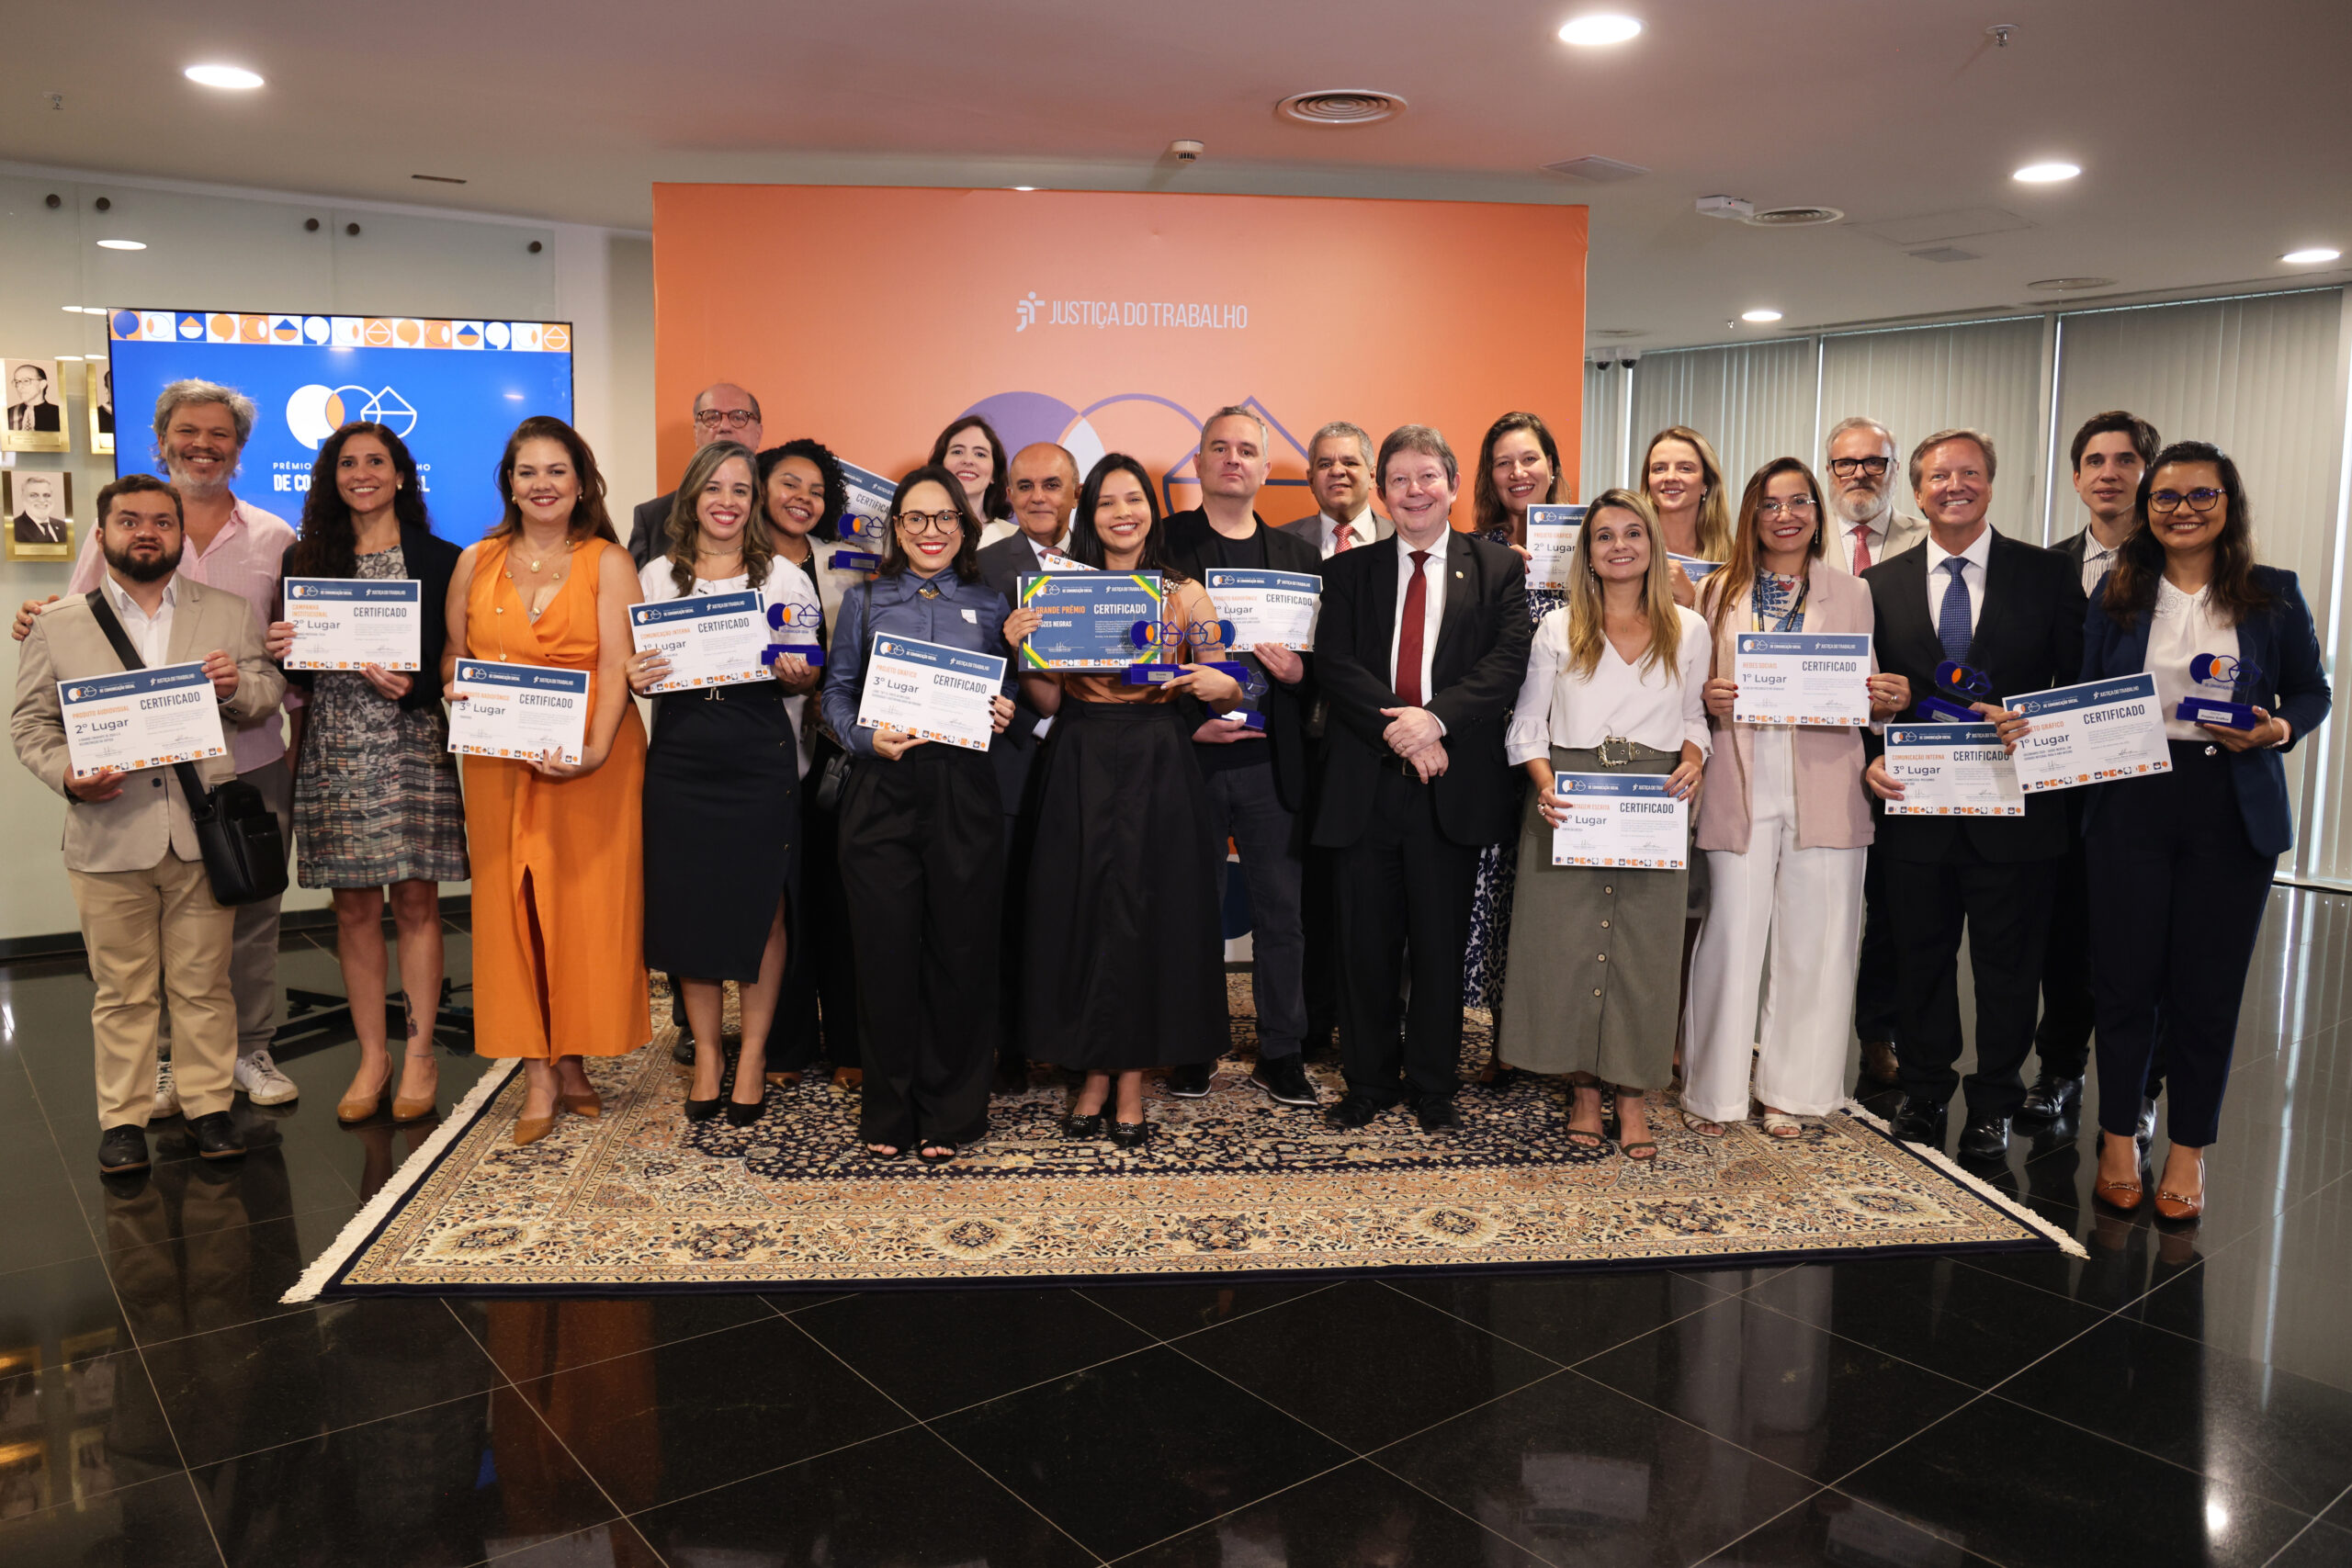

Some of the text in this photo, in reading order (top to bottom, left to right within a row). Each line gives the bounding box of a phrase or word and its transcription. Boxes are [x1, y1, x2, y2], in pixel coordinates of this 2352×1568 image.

[1049, 301, 1248, 329] JUSTIÇA DO TRABALHO
[273, 461, 312, 470] PRÊMIO
[274, 474, 292, 492] DE
[856, 493, 891, 514] CERTIFICA
[1547, 544, 1576, 554] Lugar
[1266, 594, 1313, 607] CERTIFICADO
[354, 607, 407, 618] CERTIFICADO
[1036, 604, 1086, 615] GRANDE PRÊMIO
[1093, 604, 1148, 615] CERTIFICADO
[1225, 607, 1254, 615] Lugar
[308, 620, 341, 631] Lugar
[698, 617, 750, 634] CERTIFICADO
[1803, 661, 1857, 671] CERTIFICADO
[934, 674, 988, 694] CERTIFICADO
[1755, 674, 1787, 685] Lugar
[888, 680, 920, 694] Lugar
[141, 692, 201, 710] CERTIFICADO
[520, 694, 573, 709] CERTIFICADO
[73, 705, 130, 719] PRODUTO AUDIOVISUAL
[474, 704, 506, 716] Lugar
[2084, 705, 2145, 725] CERTIFICADO
[92, 719, 130, 732] Lugar
[2034, 735, 2070, 747] Lugar
[1907, 766, 1941, 776] Lugar
[1620, 802, 1674, 814] CERTIFICADO
[1576, 816, 1608, 827] Lugar
